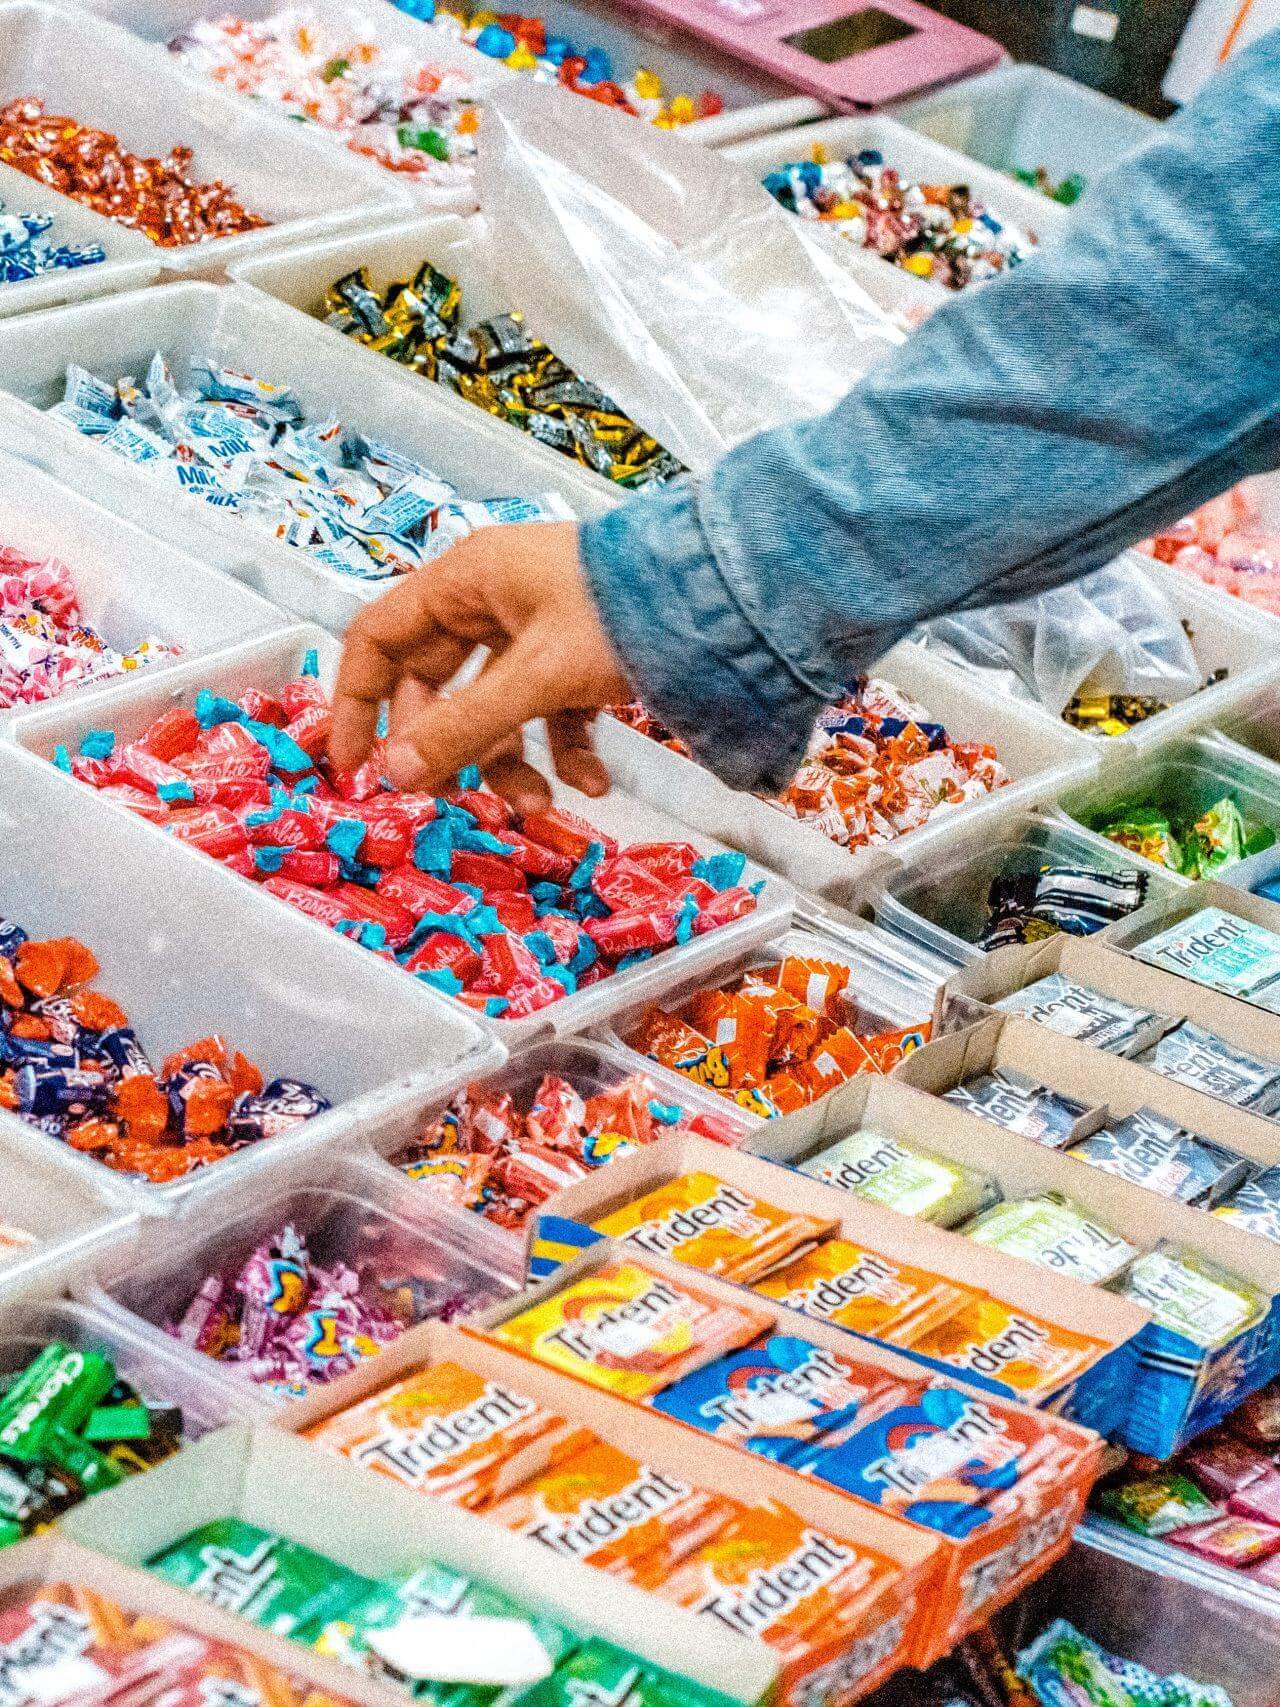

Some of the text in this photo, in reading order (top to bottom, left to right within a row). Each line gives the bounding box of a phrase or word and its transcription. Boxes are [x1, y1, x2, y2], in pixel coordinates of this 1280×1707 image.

[1157, 917, 1246, 967] Trident
[827, 1140, 908, 1191] ident
[625, 1187, 749, 1253] Trident
[794, 1256, 890, 1314] ident
[969, 1317, 1047, 1374] dent
[0, 1352, 84, 1446] Clorets
[360, 1386, 527, 1480] Trident
[527, 1471, 683, 1553] Trident
[699, 1535, 847, 1638] Trident
